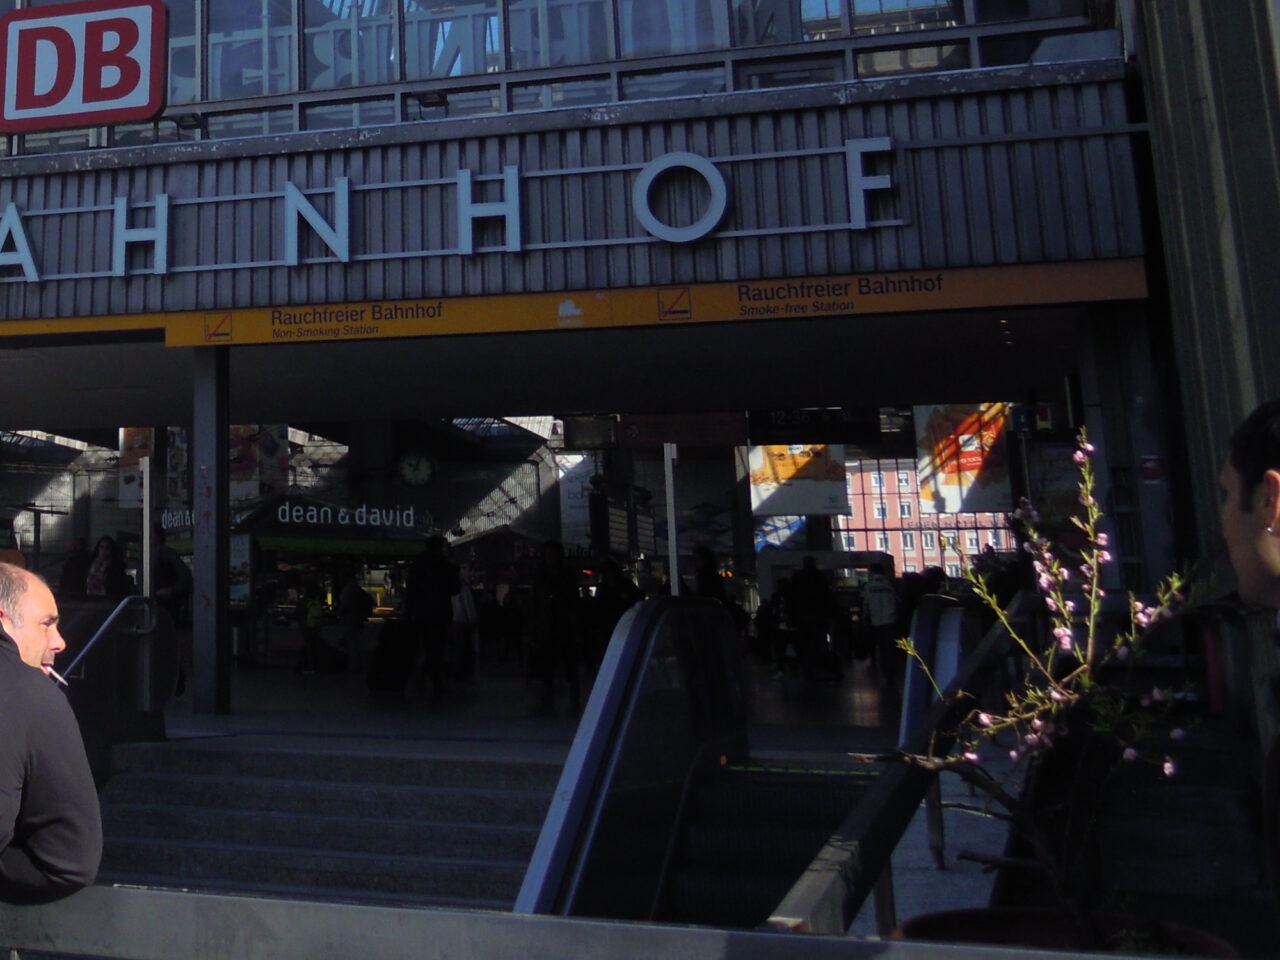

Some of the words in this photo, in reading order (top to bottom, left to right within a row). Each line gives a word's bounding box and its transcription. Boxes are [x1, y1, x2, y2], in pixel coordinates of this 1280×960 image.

[14, 16, 141, 110] DB
[738, 281, 851, 303] Rauchfreier
[858, 274, 944, 296] Bahnhof
[271, 307, 366, 326] Rauchfreier
[372, 302, 444, 321] Bahnhof
[739, 303, 809, 317] Smoke-free
[812, 301, 855, 314] Station
[272, 326, 340, 339] Non-Smoking
[344, 325, 379, 337] Station
[161, 508, 184, 530] dean
[278, 501, 332, 525] dean
[337, 506, 350, 525] &
[354, 503, 415, 528] david
